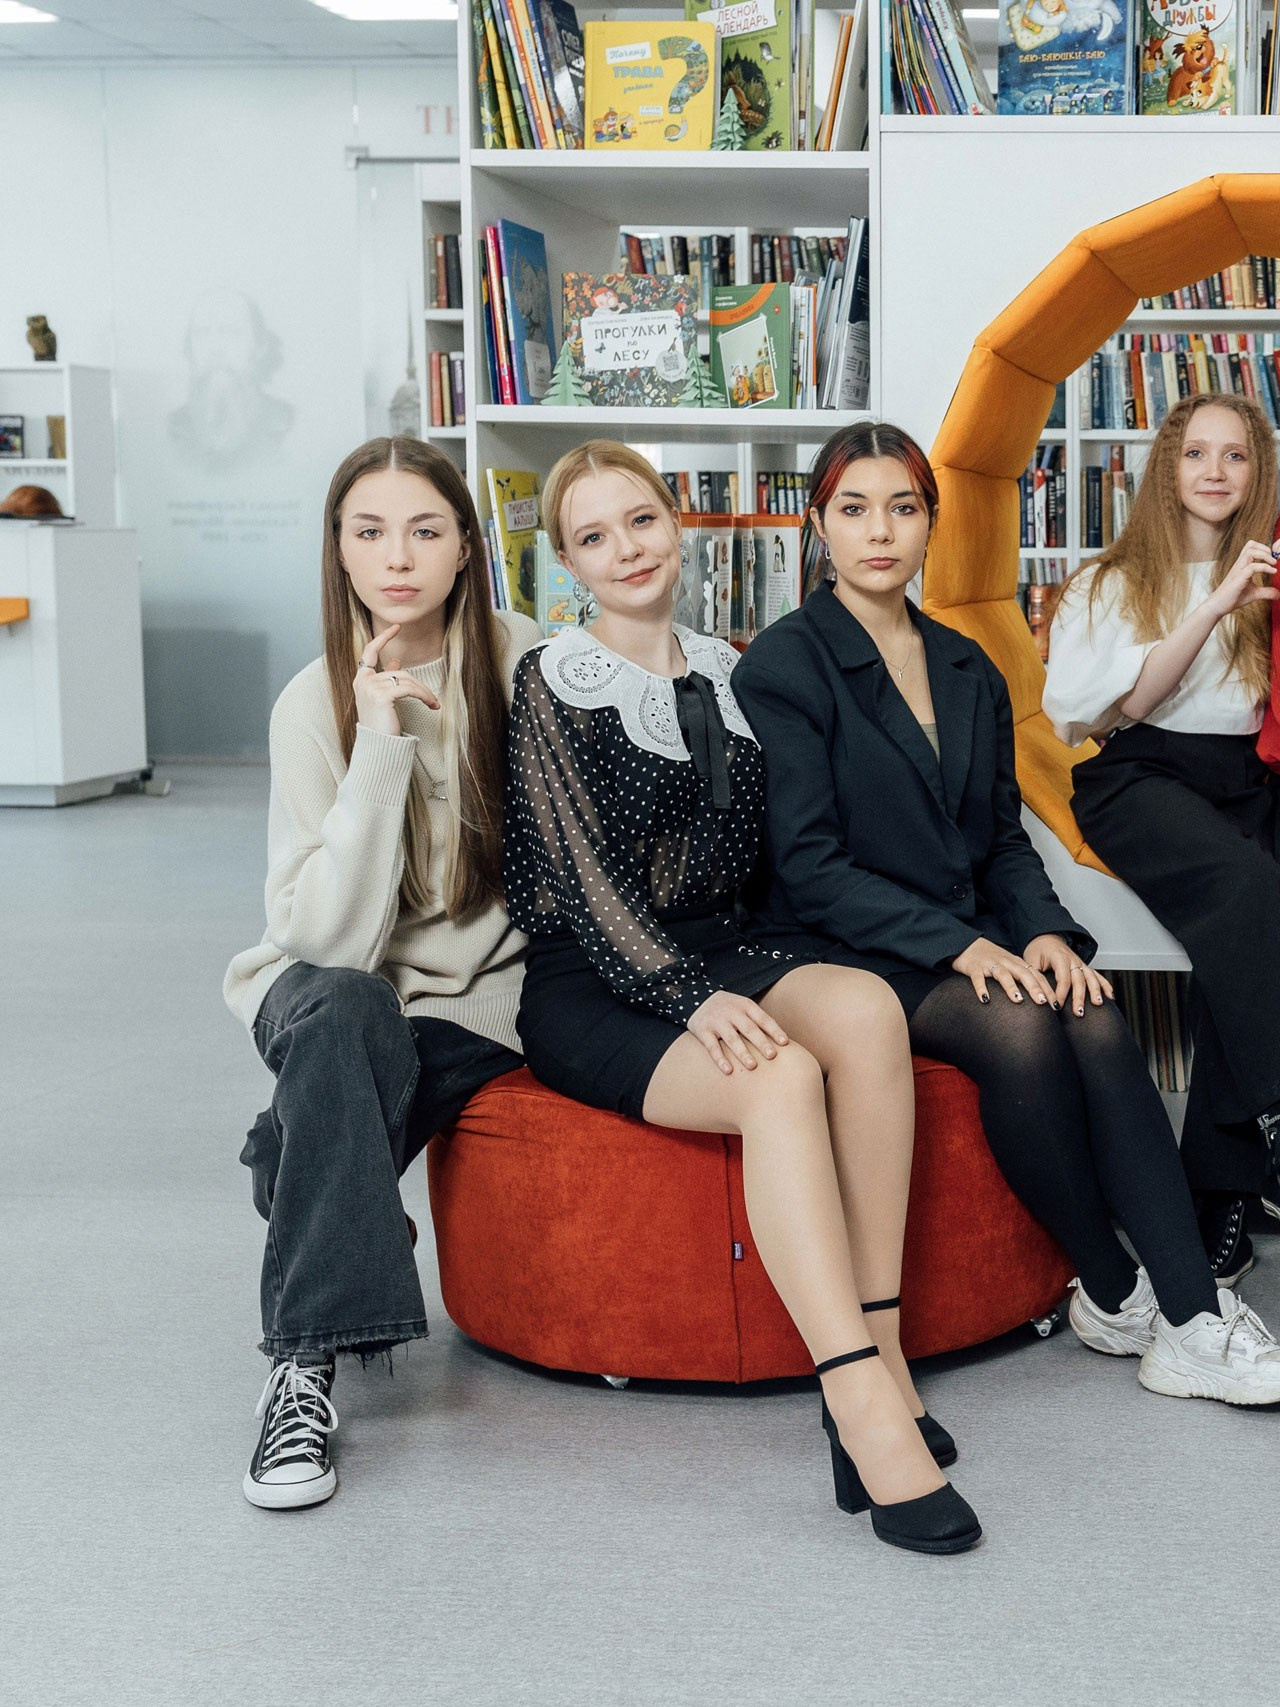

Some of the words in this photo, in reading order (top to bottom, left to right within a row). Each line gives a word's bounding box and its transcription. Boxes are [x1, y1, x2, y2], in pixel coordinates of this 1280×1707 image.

[718, 1, 759, 22] ЛЕСНОЙ
[1163, 4, 1216, 27] ДРУЖБЫ
[716, 15, 768, 36] АЛЕНДАРЬ
[613, 66, 664, 78] ТРАВА
[594, 323, 667, 339] ПРОГУЛКИ
[613, 350, 649, 362] ЛЕСУ
